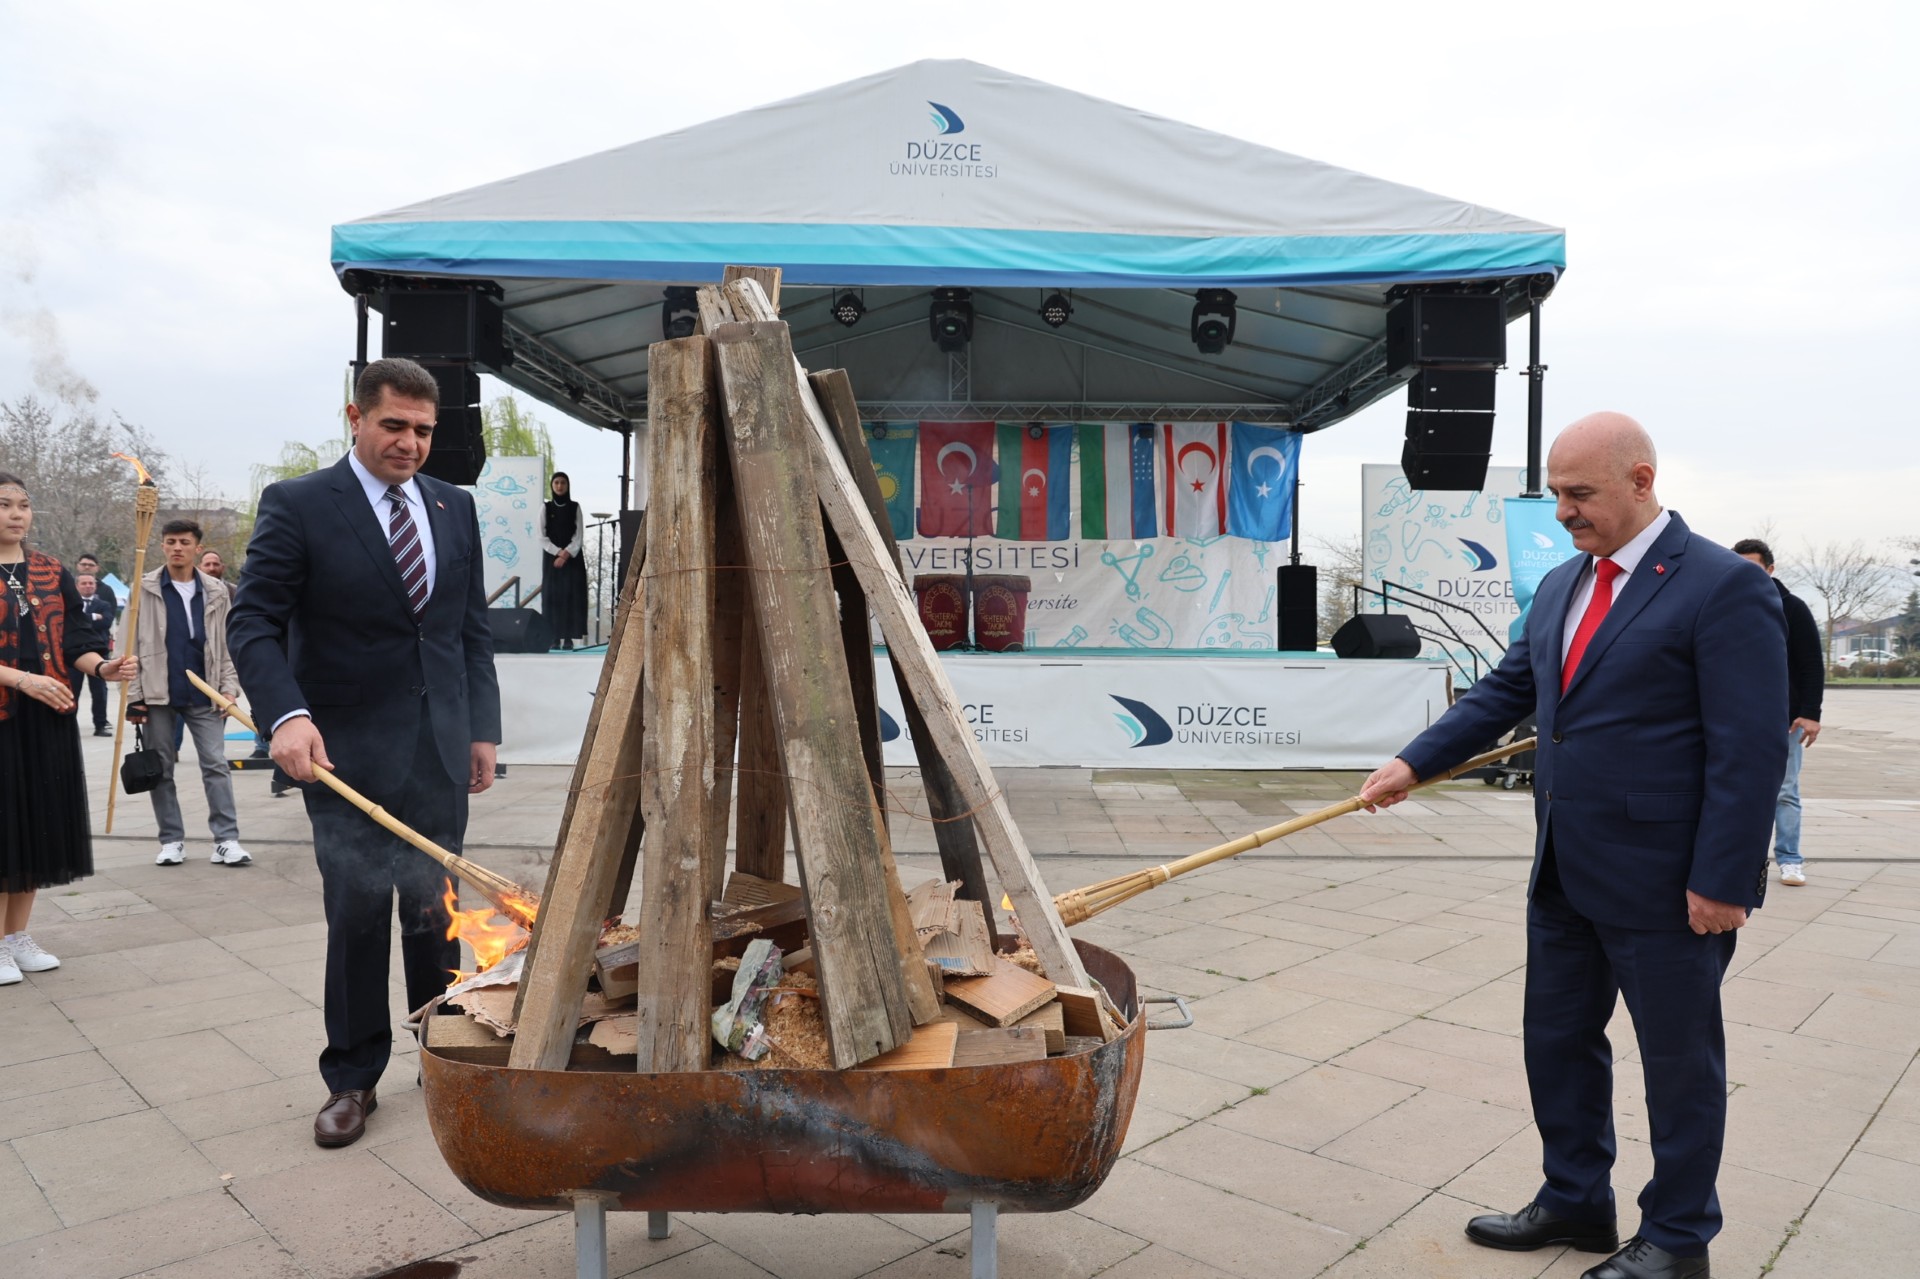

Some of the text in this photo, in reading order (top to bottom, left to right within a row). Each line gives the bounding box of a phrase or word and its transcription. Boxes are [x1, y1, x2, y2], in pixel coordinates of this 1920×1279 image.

[907, 140, 981, 161] DÜZCE
[889, 161, 998, 178] ÜNİVERSİTESİ
[897, 543, 1079, 569] VERSİTESİ
[1438, 577, 1515, 598] DÜZCE
[1028, 594, 1079, 610] ersite
[1177, 703, 1267, 726] DÜZCE
[1177, 729, 1301, 744] ÜNİVERSİTESİ
